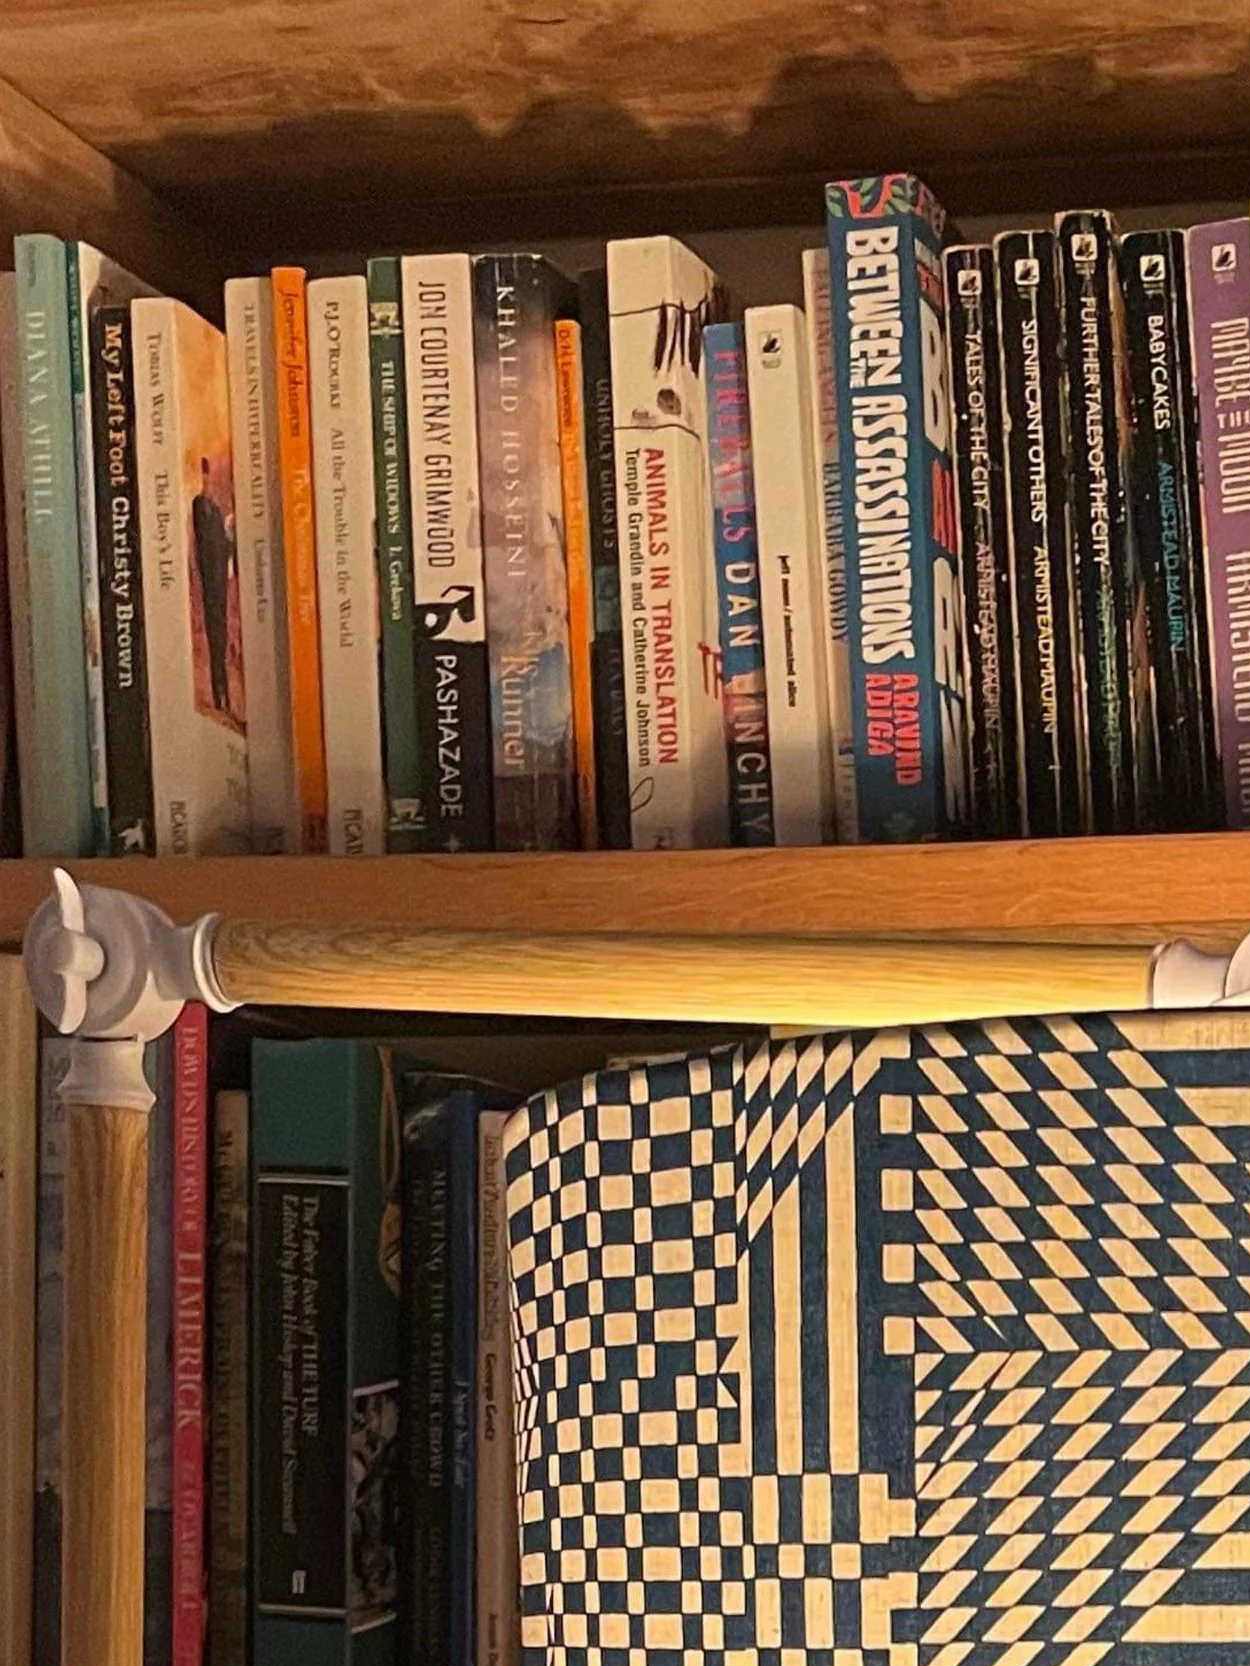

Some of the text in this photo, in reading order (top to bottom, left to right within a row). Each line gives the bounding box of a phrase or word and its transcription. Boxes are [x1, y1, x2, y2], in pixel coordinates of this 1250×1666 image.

[25, 310, 53, 520] DIANA ATHILL
[100, 324, 127, 486] My Left Foot
[417, 281, 455, 568] JON COURTENAY GRIMWOOD
[496, 287, 525, 576] KHALED HOSSEINI
[845, 226, 914, 665] BETWEEN ASSASSINATIONS
[963, 330, 990, 510] TALES CITY
[1021, 319, 1047, 522] SIGNIFICANT OTHERS
[1079, 295, 1104, 447] FURTHER TALES
[1147, 315, 1171, 430] BABYCAKES
[110, 496, 136, 688] Christy Brown
[332, 486, 350, 545] Trouble
[724, 561, 760, 648] DAN
[623, 448, 652, 768] Temple Grandin and Catherine Johnson
[644, 448, 679, 764] ANIMALS IN TRANSLATION
[1033, 545, 1056, 733] ARMISTEAD MAUPIN
[434, 654, 462, 817] PASHAZADE
[866, 672, 892, 757] ADIGA
[893, 672, 922, 786] ARAVIND
[177, 1251, 203, 1429] LIMERICK
